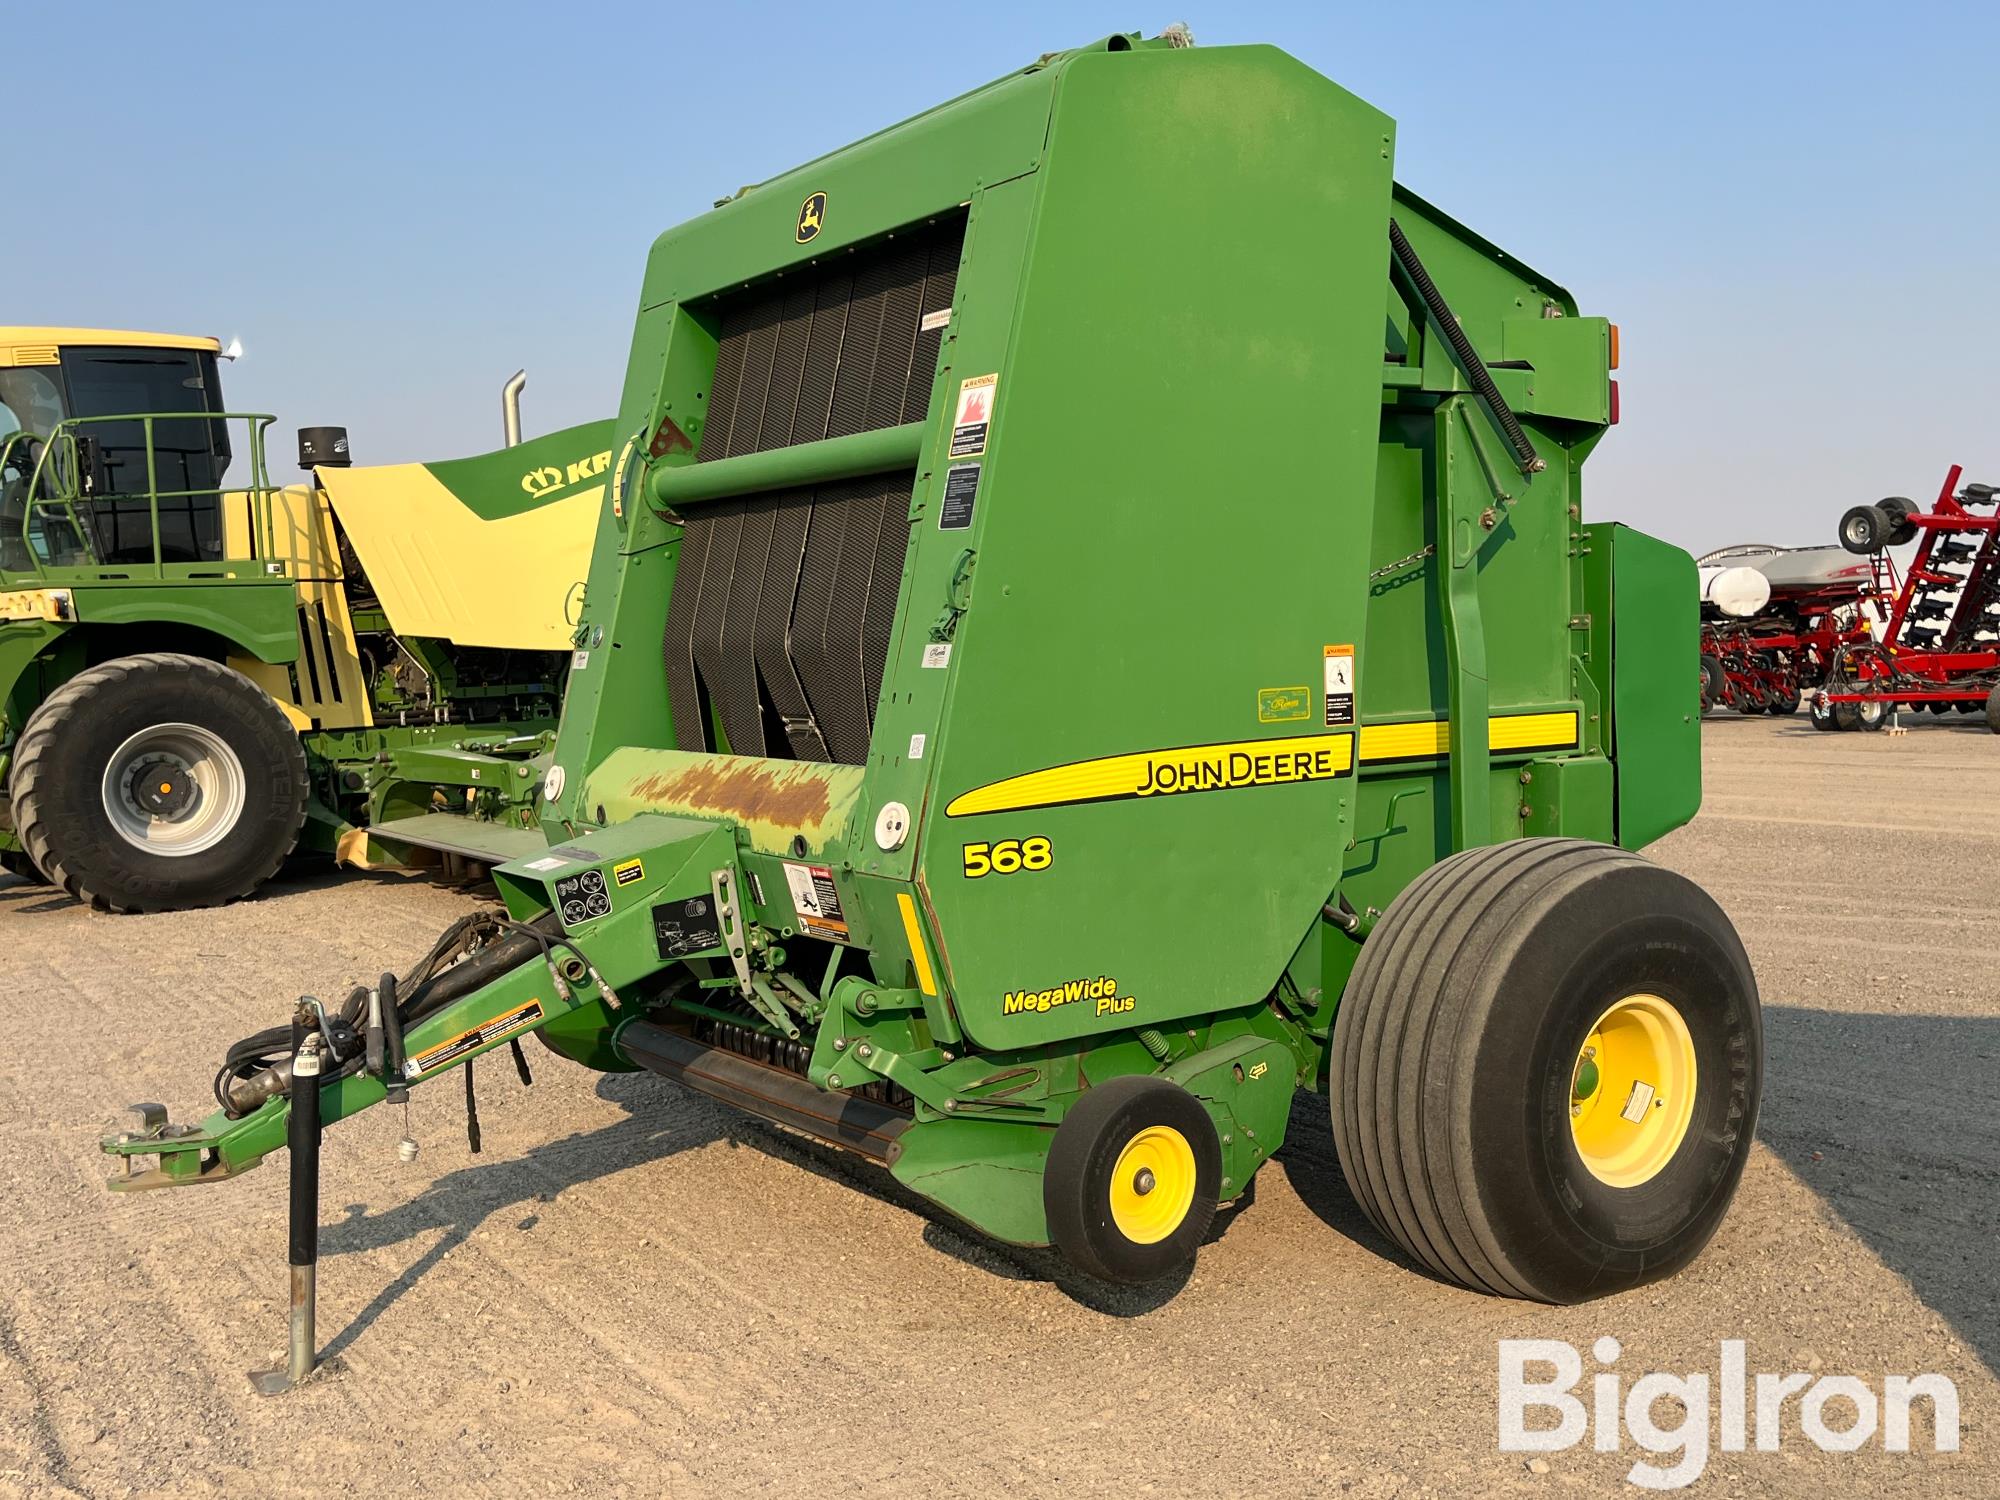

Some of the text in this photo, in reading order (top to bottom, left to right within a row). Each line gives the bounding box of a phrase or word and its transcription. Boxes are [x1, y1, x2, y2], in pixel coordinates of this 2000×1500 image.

[1136, 750, 1333, 792] JOHN DEERE
[962, 835, 1054, 879] 568
[1003, 975, 1117, 1016] MegaWide
[1096, 994, 1136, 1018] Plus
